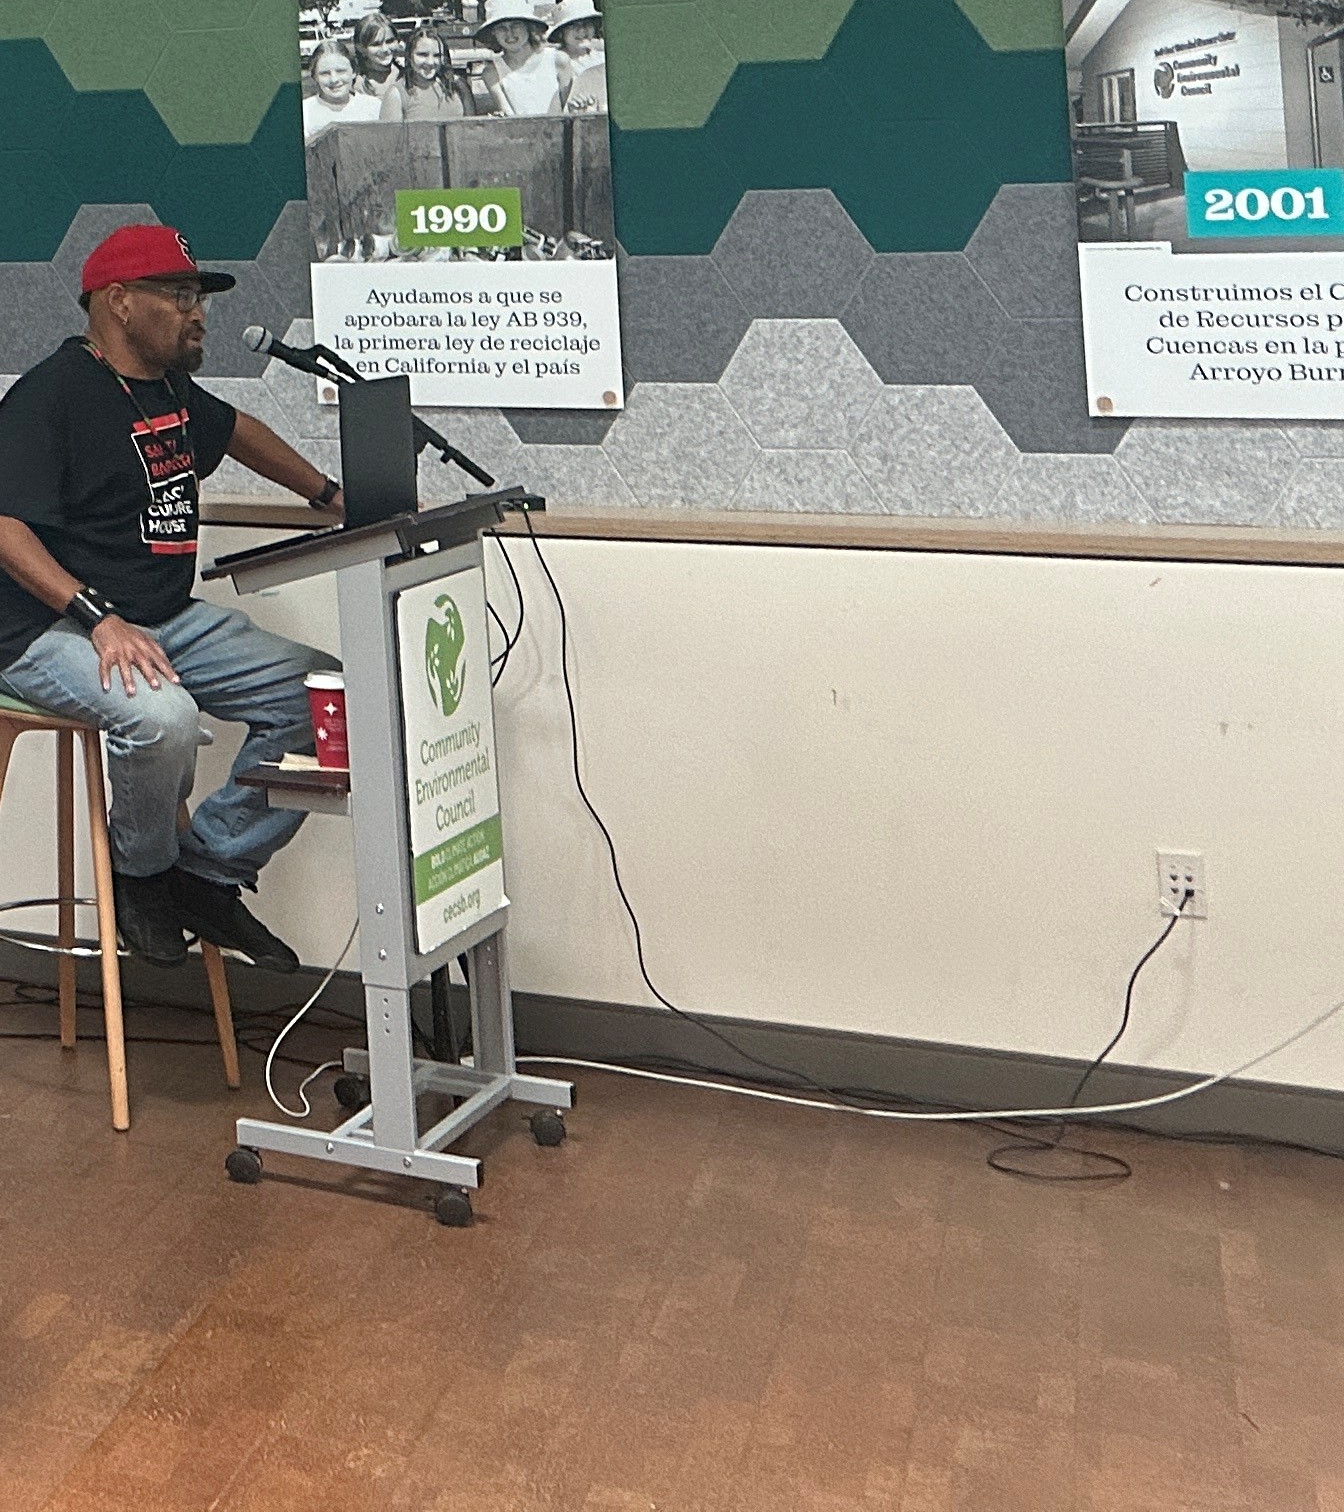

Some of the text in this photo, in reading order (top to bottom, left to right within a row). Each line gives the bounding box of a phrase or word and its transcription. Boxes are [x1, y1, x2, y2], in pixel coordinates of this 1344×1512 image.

[1204, 186, 1330, 221] 2001
[410, 203, 508, 234] 1990
[365, 288, 562, 307] Ayudamos a que se
[1124, 283, 1293, 302] Construimos
[1300, 283, 1323, 301] el
[344, 311, 588, 331] aprobara la ley AB 939,
[1159, 310, 1190, 328] de
[1196, 310, 1320, 328] Recursos
[334, 335, 601, 355] la primera ley de reciclaje
[1146, 336, 1258, 355] Cuencas
[1265, 339, 1297, 354] en
[1302, 336, 1329, 354] la
[356, 357, 581, 378] en California y el país
[1189, 363, 1283, 385] Arroyo
[420, 719, 480, 767] Community
[415, 746, 490, 805] Environmental
[436, 788, 476, 831] Council
